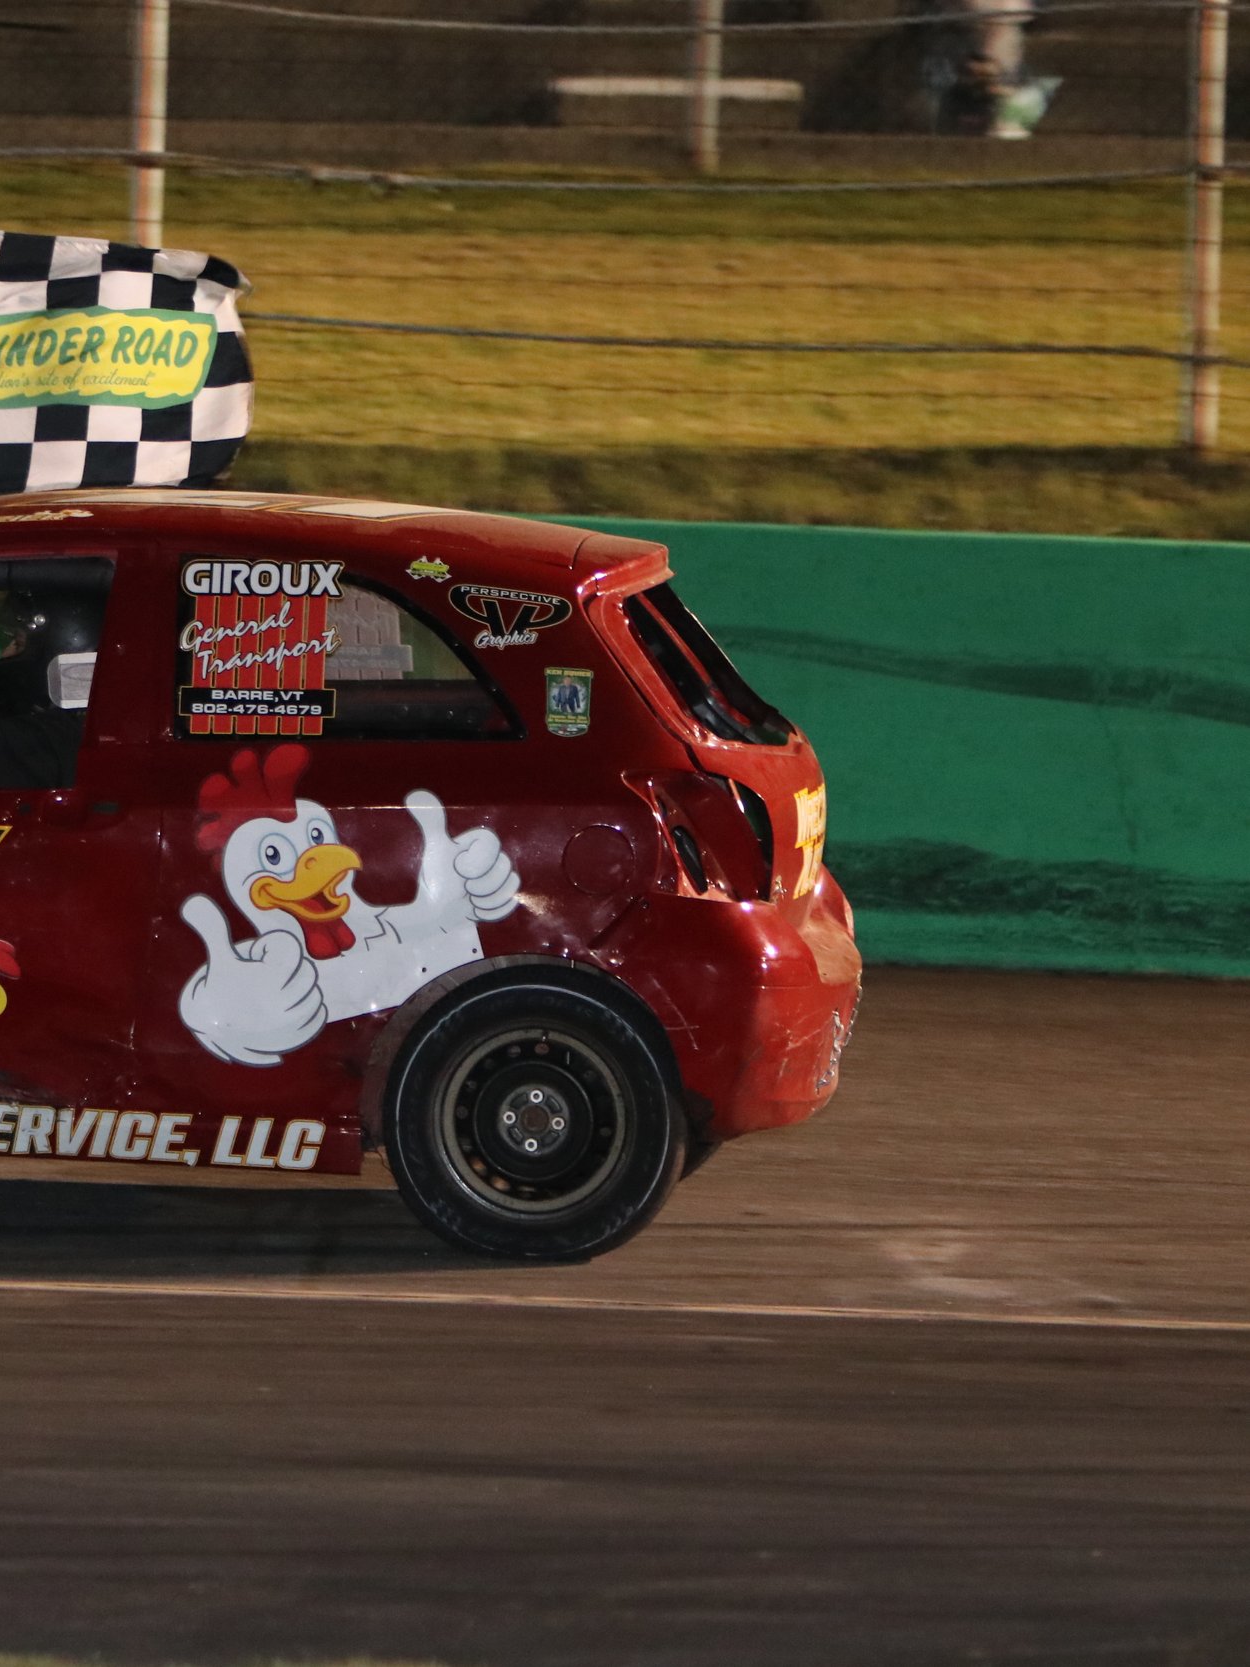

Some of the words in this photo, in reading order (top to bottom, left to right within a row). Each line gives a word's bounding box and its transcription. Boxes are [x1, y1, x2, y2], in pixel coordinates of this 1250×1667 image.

[111, 326, 199, 368] ROAD
[62, 367, 83, 390] of
[184, 562, 342, 597] GIROUX
[460, 586, 561, 606] PERSPECTIVE
[181, 600, 295, 652] General
[475, 630, 538, 650] Graphics
[197, 629, 341, 679] Transport
[191, 703, 322, 715] 802-476-4679
[211, 1115, 327, 1171] LLC
